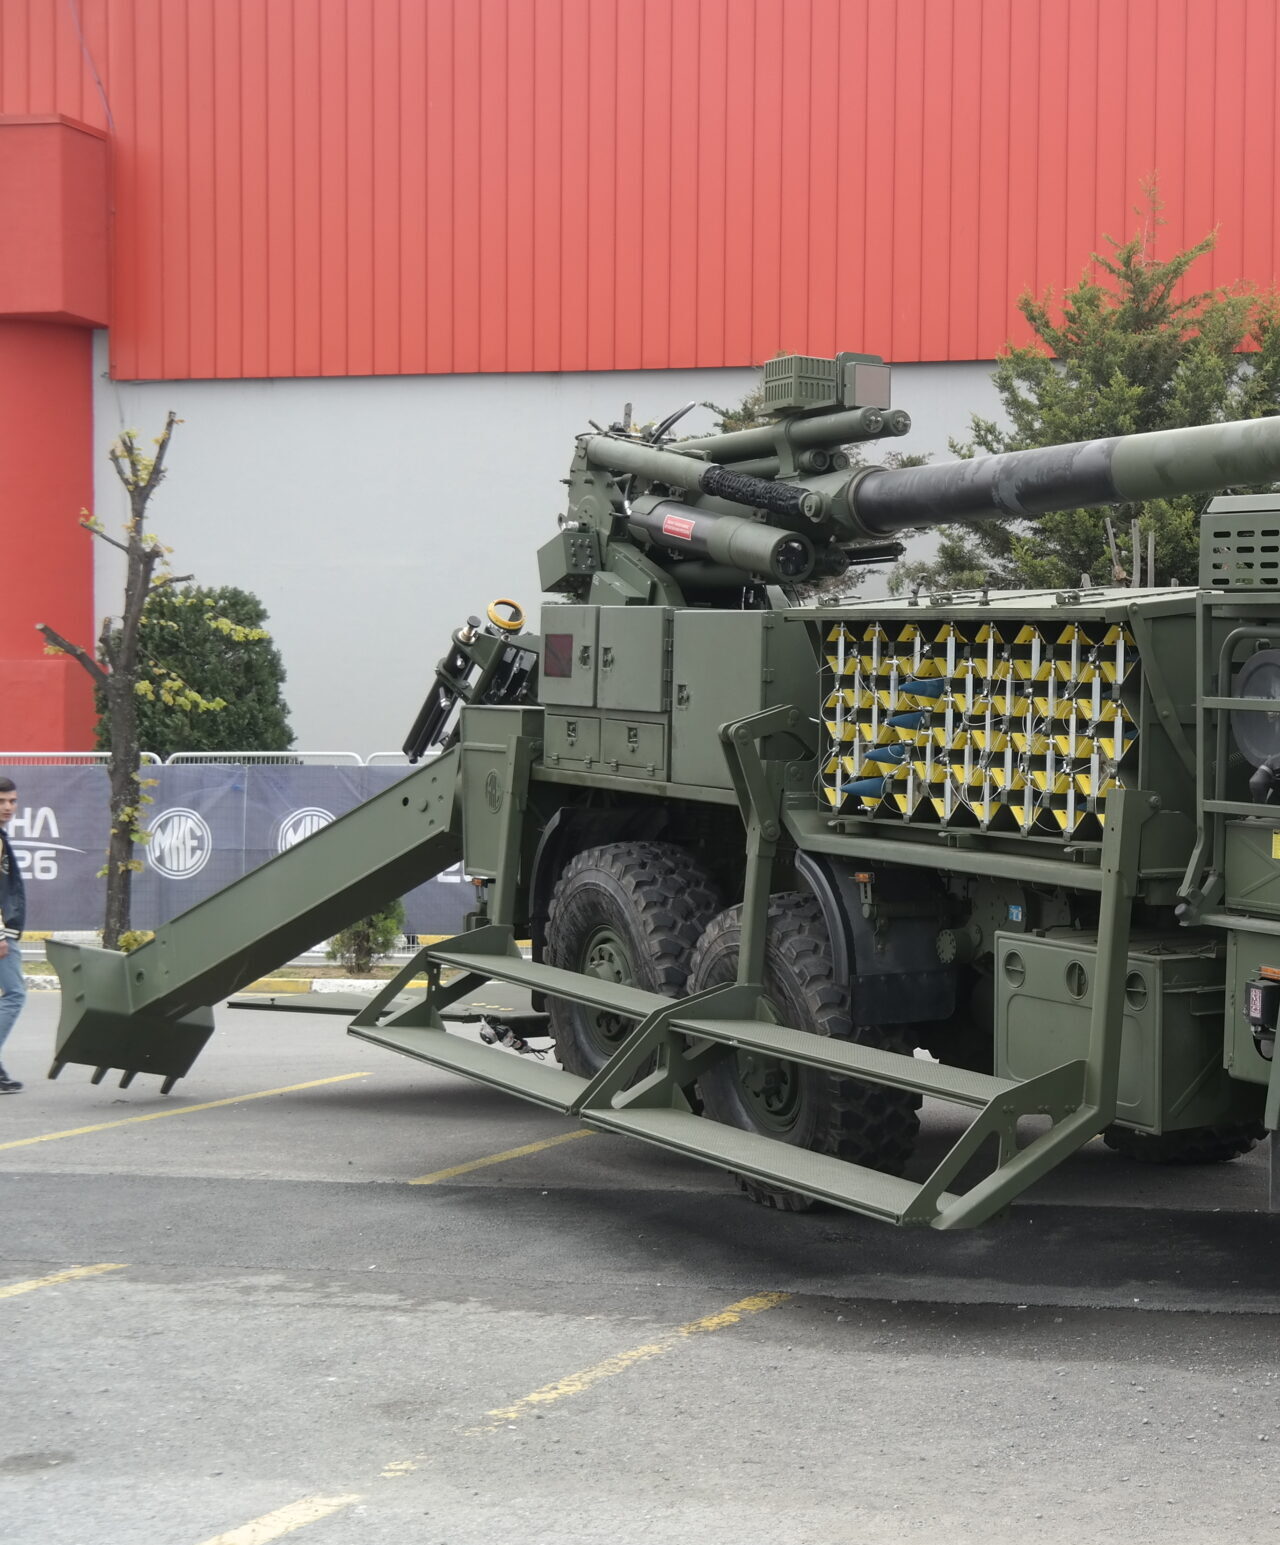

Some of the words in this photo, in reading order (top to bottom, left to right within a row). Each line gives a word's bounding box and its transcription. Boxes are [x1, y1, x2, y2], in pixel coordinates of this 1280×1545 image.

[8, 806, 60, 838] HA
[155, 816, 202, 871] MKE
[15, 850, 58, 880] 26
